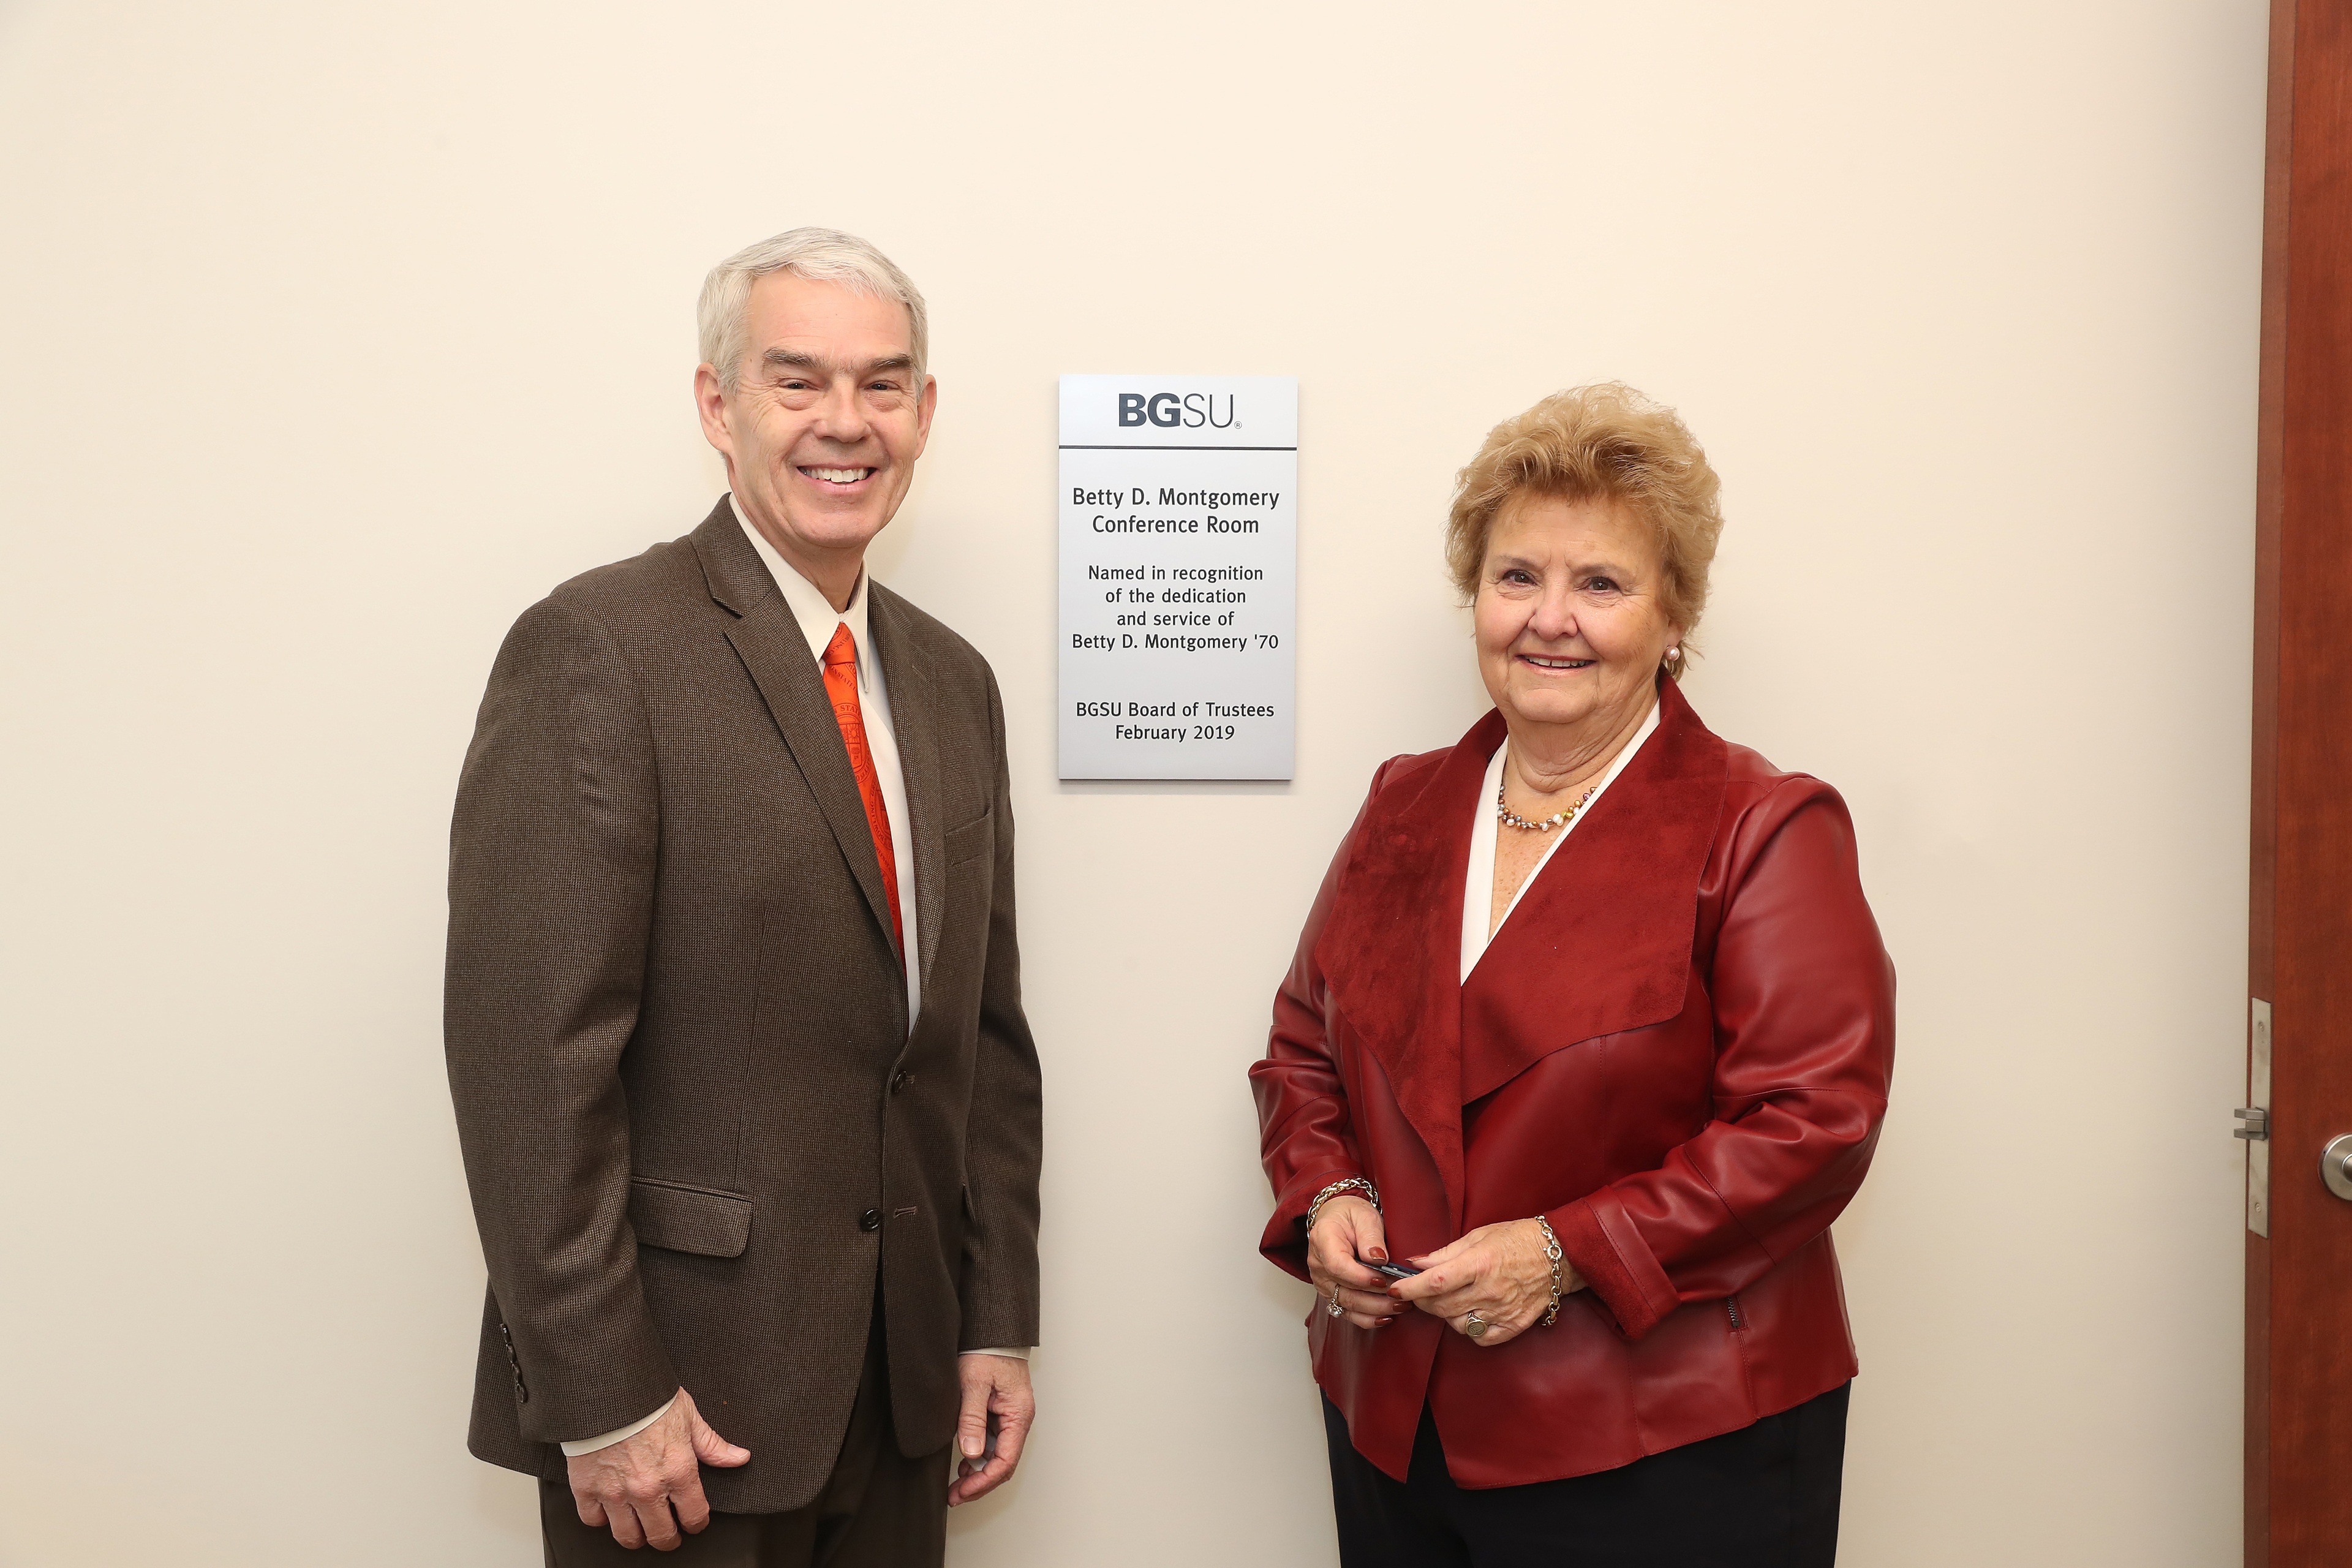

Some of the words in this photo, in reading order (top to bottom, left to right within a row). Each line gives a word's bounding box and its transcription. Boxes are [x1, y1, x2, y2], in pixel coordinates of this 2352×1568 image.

[1073, 488, 1124, 510] Betty
[1132, 488, 1150, 506] D.
[1159, 488, 1280, 510] Montgomery
[1093, 514, 1199, 533] Conference
[1207, 515, 1259, 533] Room
[1088, 565, 1145, 581] Named
[1152, 565, 1166, 581] in
[1173, 565, 1263, 584] recognition
[1106, 587, 1123, 603] of
[1129, 587, 1155, 603] the
[1162, 587, 1246, 603] dedication
[1117, 611, 1146, 626] and
[1153, 611, 1211, 626] service
[1218, 611, 1235, 626] of
[1072, 633, 1115, 652] Betty
[1122, 634, 1138, 649] D.
[1145, 634, 1248, 652] Montgomery
[1254, 634, 1279, 649] '70
[1076, 701, 1122, 717] BGSU
[1129, 701, 1175, 717] Board
[1182, 701, 1199, 717] of
[1205, 702, 1275, 717] Trustees
[1115, 724, 1187, 743] February
[1194, 725, 1235, 741] 2019
